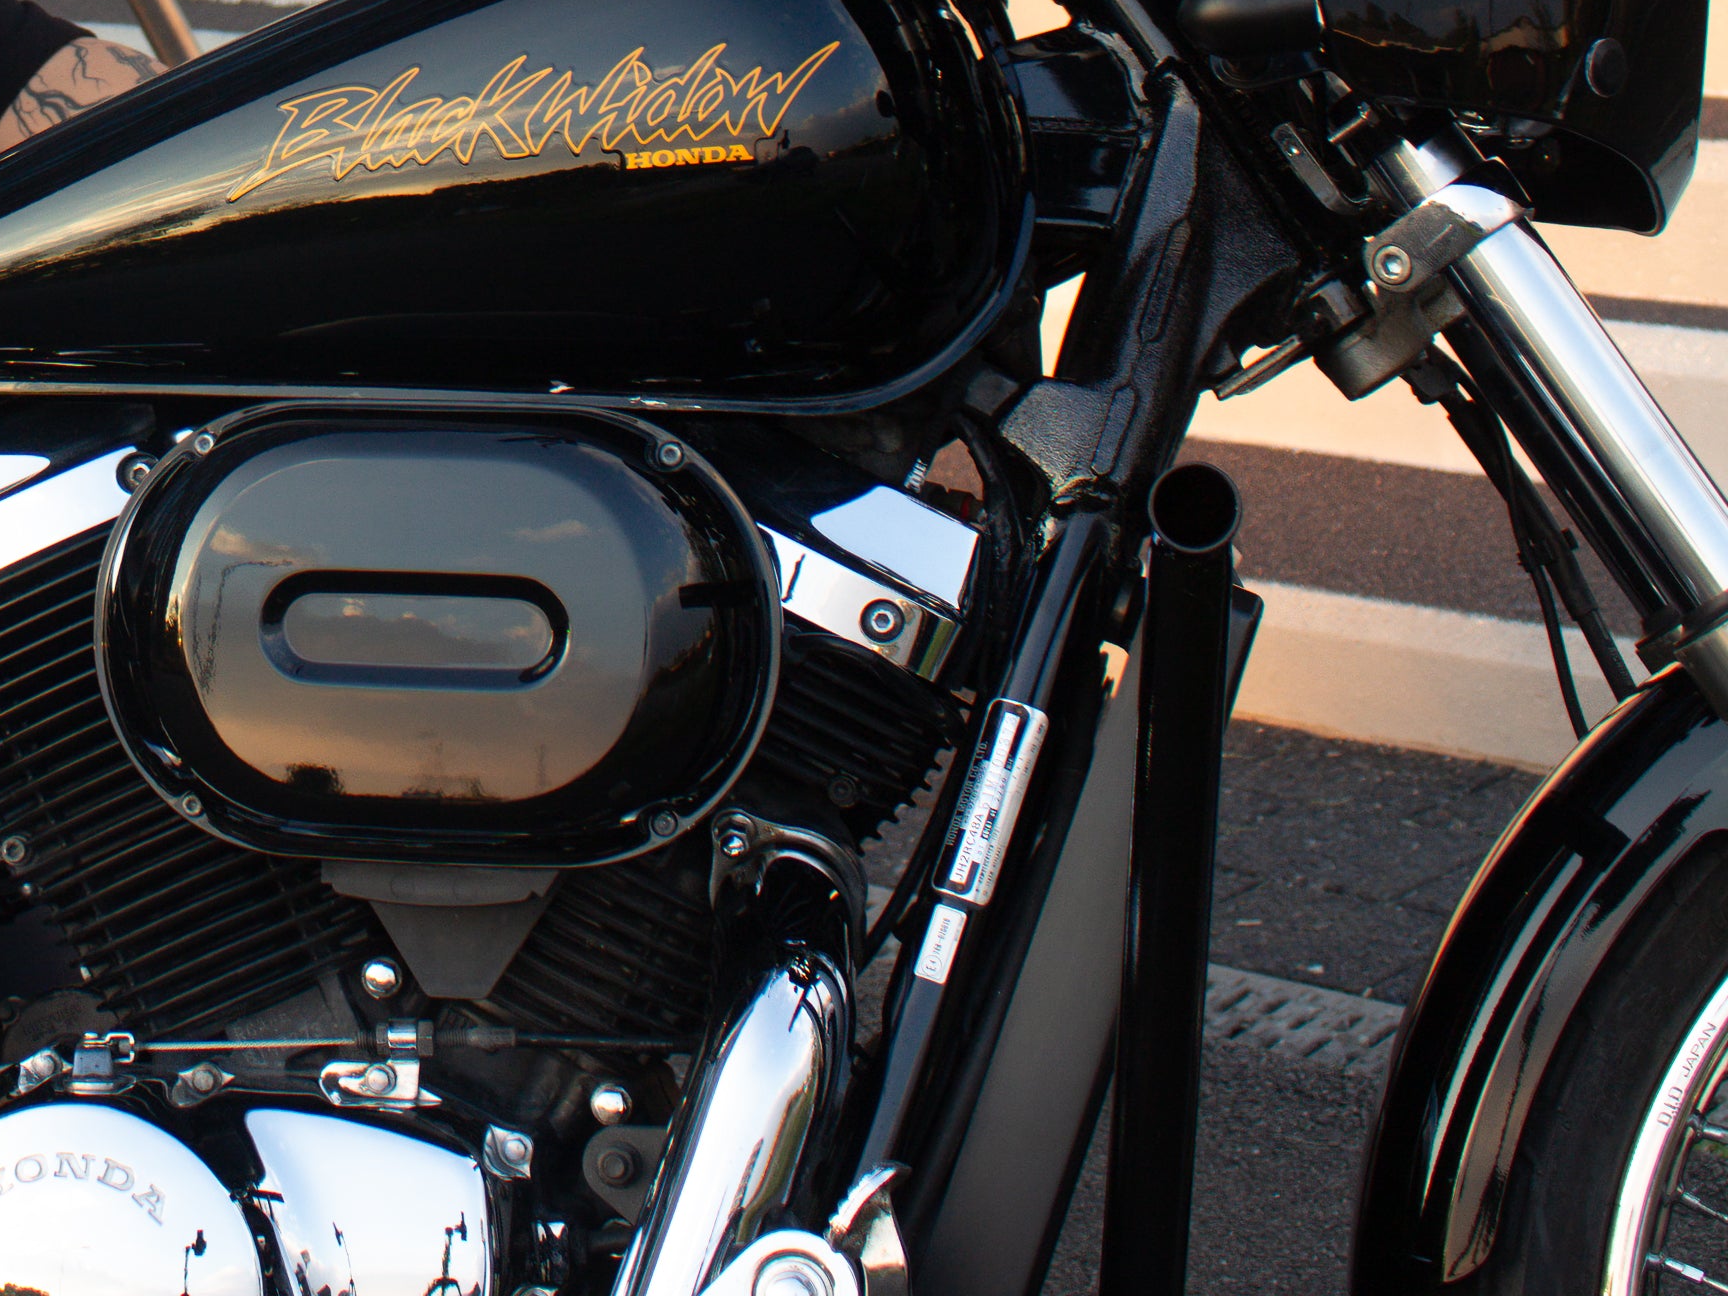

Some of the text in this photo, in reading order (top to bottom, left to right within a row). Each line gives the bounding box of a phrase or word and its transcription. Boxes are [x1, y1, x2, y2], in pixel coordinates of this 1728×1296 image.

[624, 143, 755, 171] HONDA
[945, 813, 964, 847] HONDA
[957, 780, 975, 812] MOTOR
[1683, 1021, 1718, 1078] JAPAN
